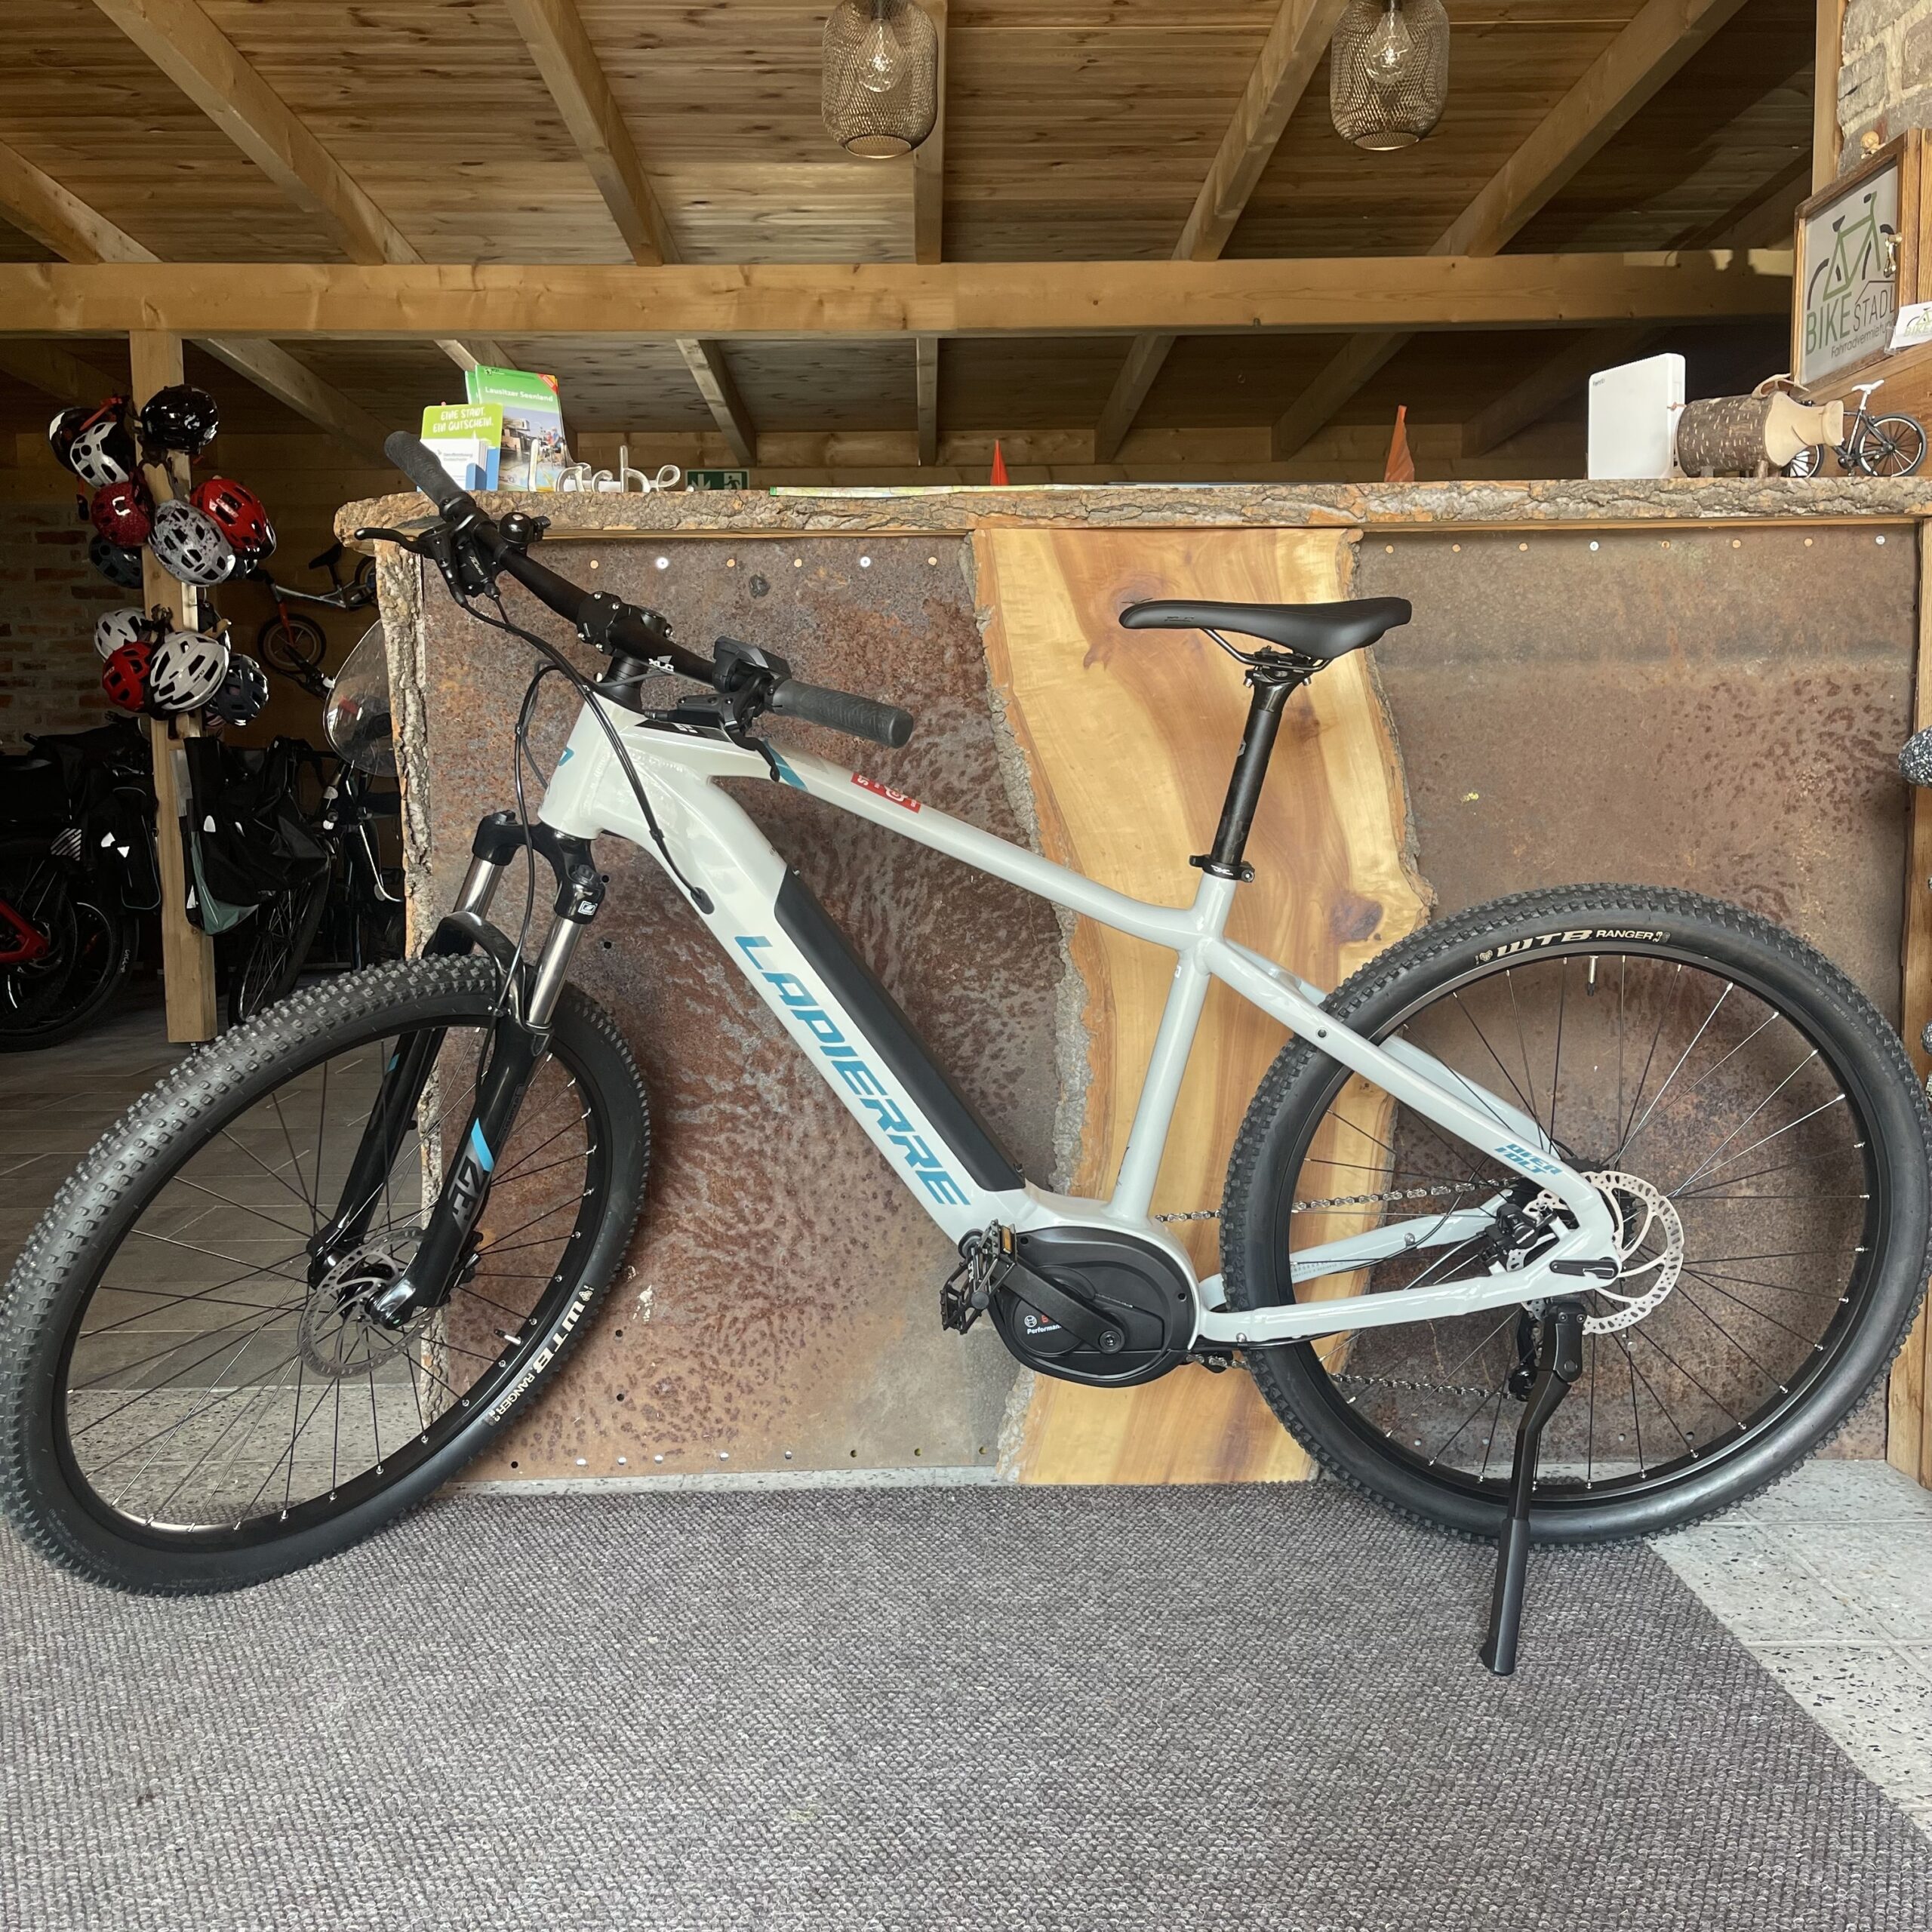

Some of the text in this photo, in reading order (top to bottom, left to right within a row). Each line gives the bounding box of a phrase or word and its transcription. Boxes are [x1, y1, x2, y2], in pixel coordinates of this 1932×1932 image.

[1805, 285, 1896, 356] BIKE STADL
[485, 386, 553, 402] Lausitzer Seenland
[432, 423, 447, 433] EIN
[440, 409, 459, 421] EINE
[648, 658, 675, 672] XLC
[1497, 930, 1593, 957] WTB
[1595, 929, 1654, 940] RANGER
[734, 935, 971, 1206] LAPIERRE
[1495, 1147, 1548, 1174] VOLT
[1506, 1143, 1563, 1175] OVER
[532, 1300, 586, 1374] WTB
[1026, 1324, 1063, 1335] Performan
[495, 1372, 535, 1416] RANGER
